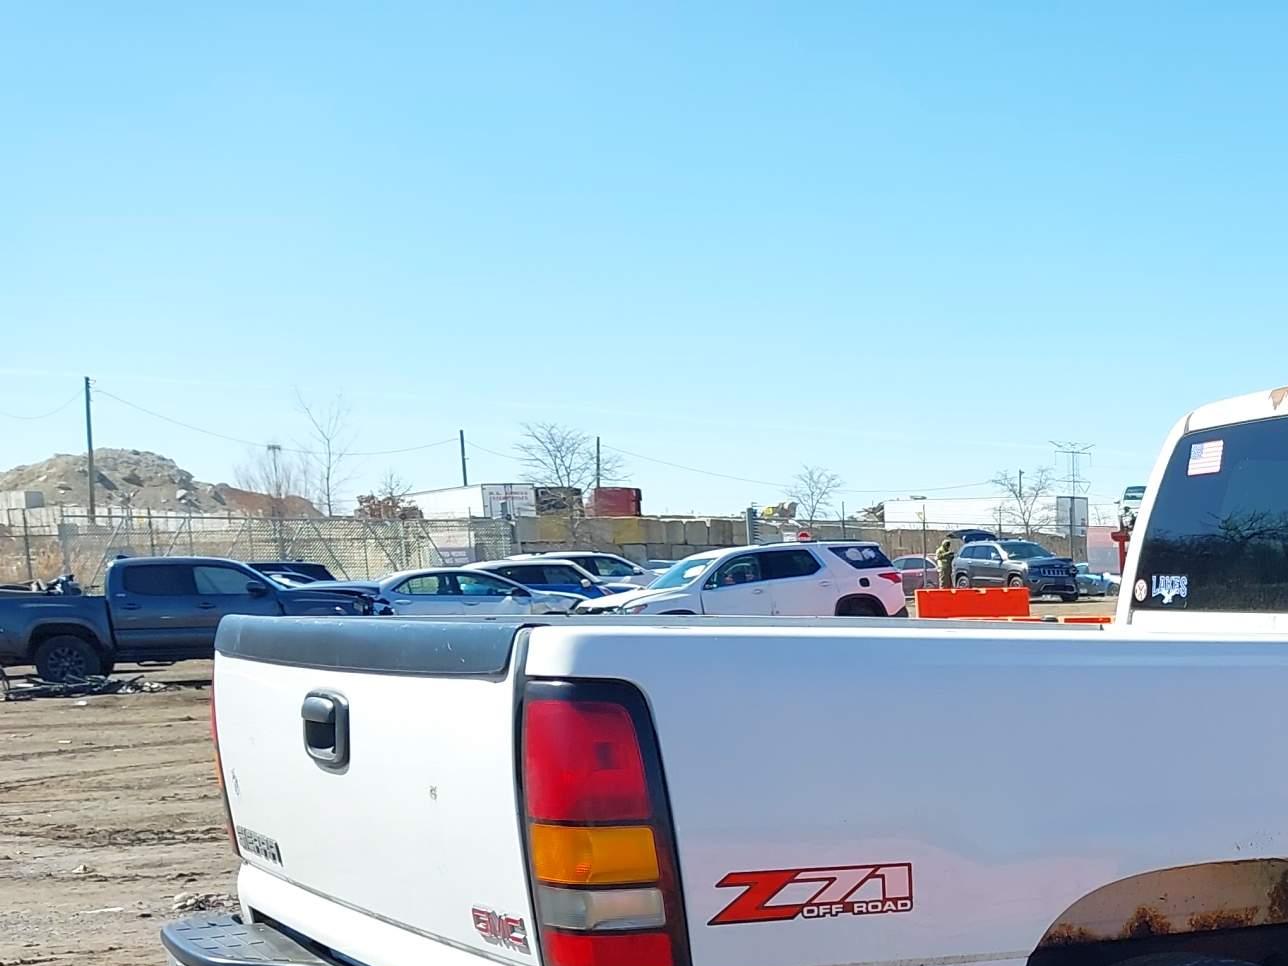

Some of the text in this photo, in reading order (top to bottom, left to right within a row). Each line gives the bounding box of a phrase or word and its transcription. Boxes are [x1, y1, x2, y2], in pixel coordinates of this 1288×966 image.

[1152, 575, 1188, 598] LAKES
[707, 862, 912, 926] Z71
[802, 899, 912, 919] OFF ROAD
[471, 907, 527, 948] GMC
